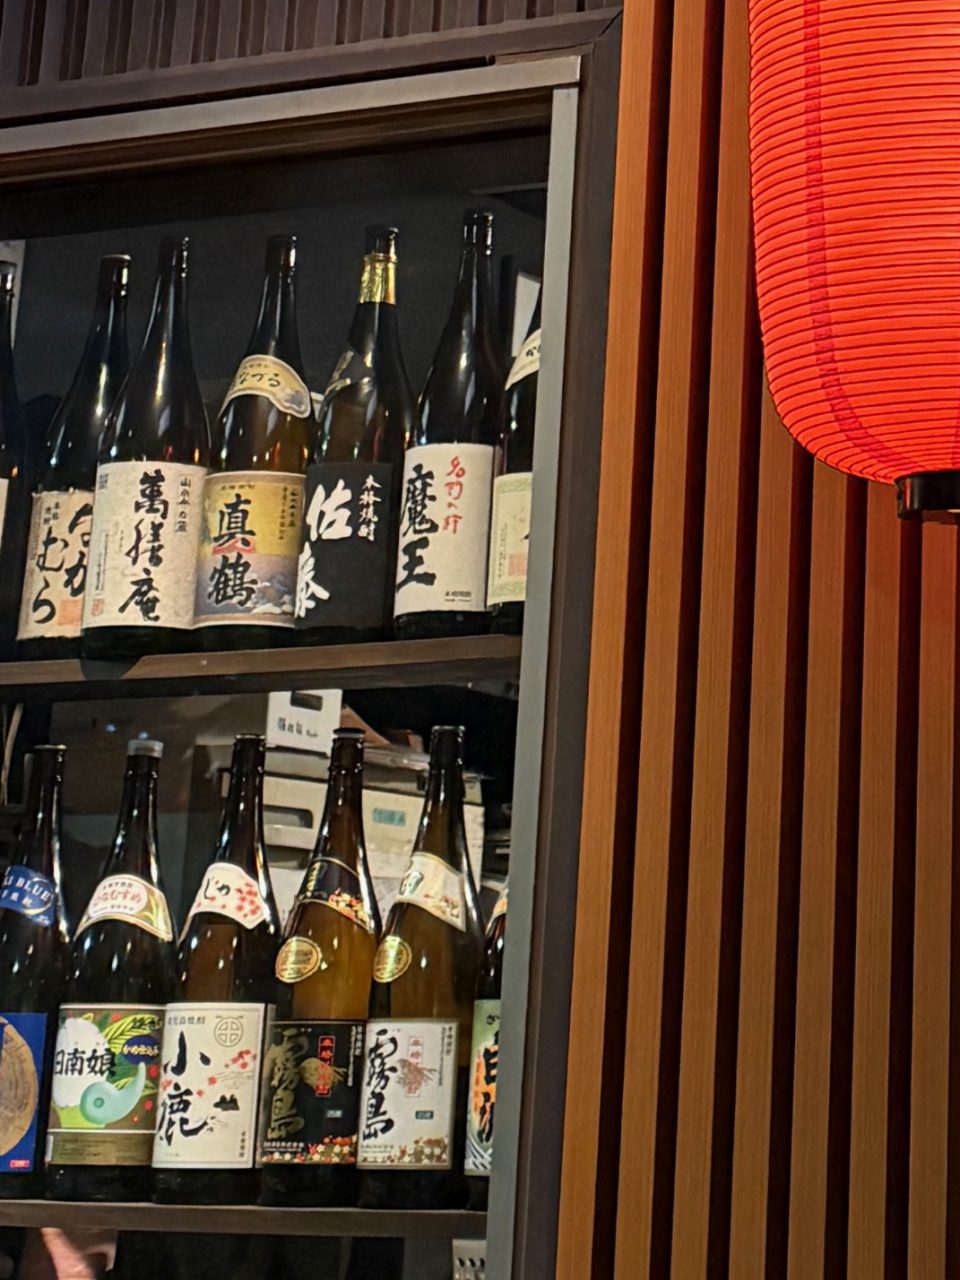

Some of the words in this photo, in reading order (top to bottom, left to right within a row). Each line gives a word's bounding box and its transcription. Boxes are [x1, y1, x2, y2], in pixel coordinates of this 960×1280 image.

[207, 492, 259, 608] 真鶴
[396, 463, 439, 594] 魔王
[157, 1030, 211, 1147] 小鹿
